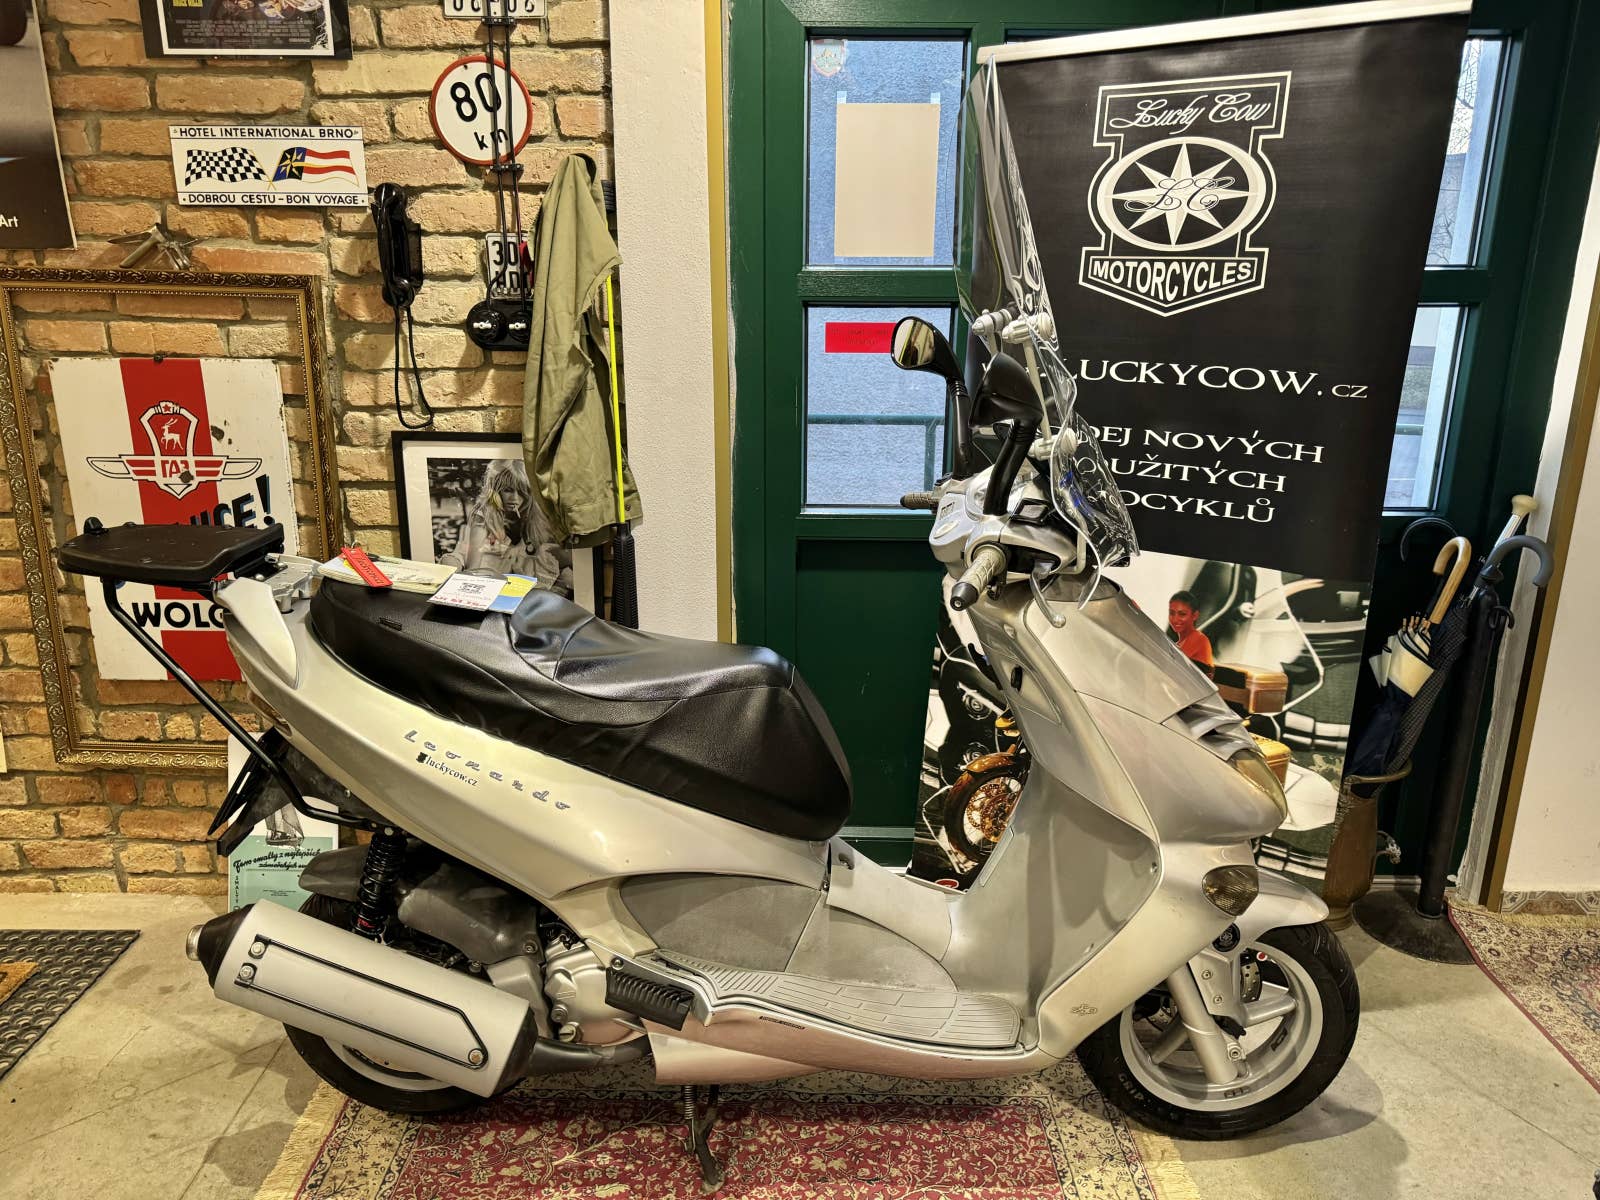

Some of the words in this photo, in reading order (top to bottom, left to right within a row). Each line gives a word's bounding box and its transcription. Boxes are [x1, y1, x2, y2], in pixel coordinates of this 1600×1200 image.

[450, 72, 502, 123] 80
[1109, 95, 1209, 134] Lucky
[1208, 92, 1271, 123] Cow
[180, 127, 217, 137] HOTEL
[220, 127, 315, 138] INTERNATIONAL
[319, 129, 354, 138] BRNO
[474, 128, 509, 150] km
[188, 194, 236, 203] DOBROU
[241, 194, 276, 204] CESTU
[286, 195, 310, 204] BON
[314, 195, 359, 204] VOYAGE
[0, 213, 18, 228] Art
[1093, 260, 1252, 301] MOTORCYCLES
[1078, 425, 1133, 448] DEJ
[1143, 429, 1325, 463] NOVÝCH
[1121, 489, 1276, 523] OCYKLŮ
[132, 601, 225, 629] WOLG
[403, 729, 571, 811] Leonardo
[425, 755, 479, 787] luckycow.cz
